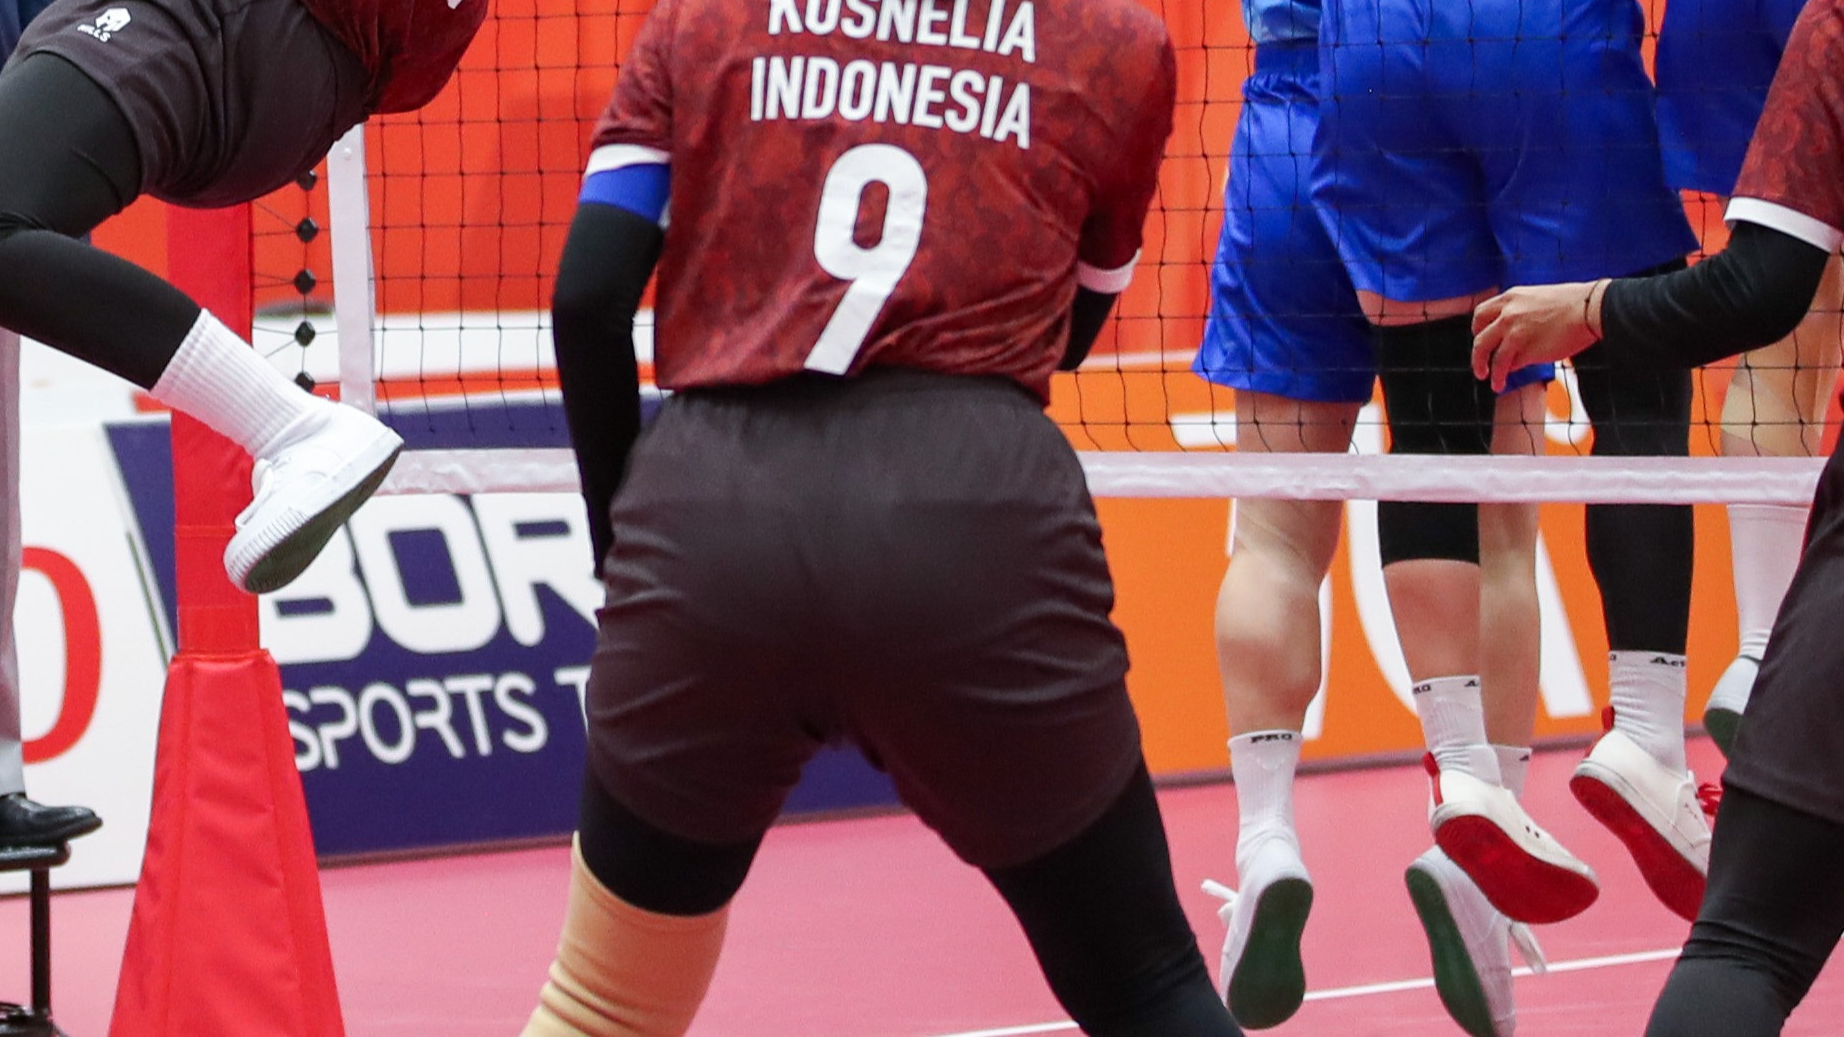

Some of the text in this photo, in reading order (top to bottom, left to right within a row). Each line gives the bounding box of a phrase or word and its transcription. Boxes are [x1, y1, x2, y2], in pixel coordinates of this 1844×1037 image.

[750, 56, 1031, 150] INDONESIA
[804, 143, 928, 376] 9
[282, 671, 549, 771] SPORTS
